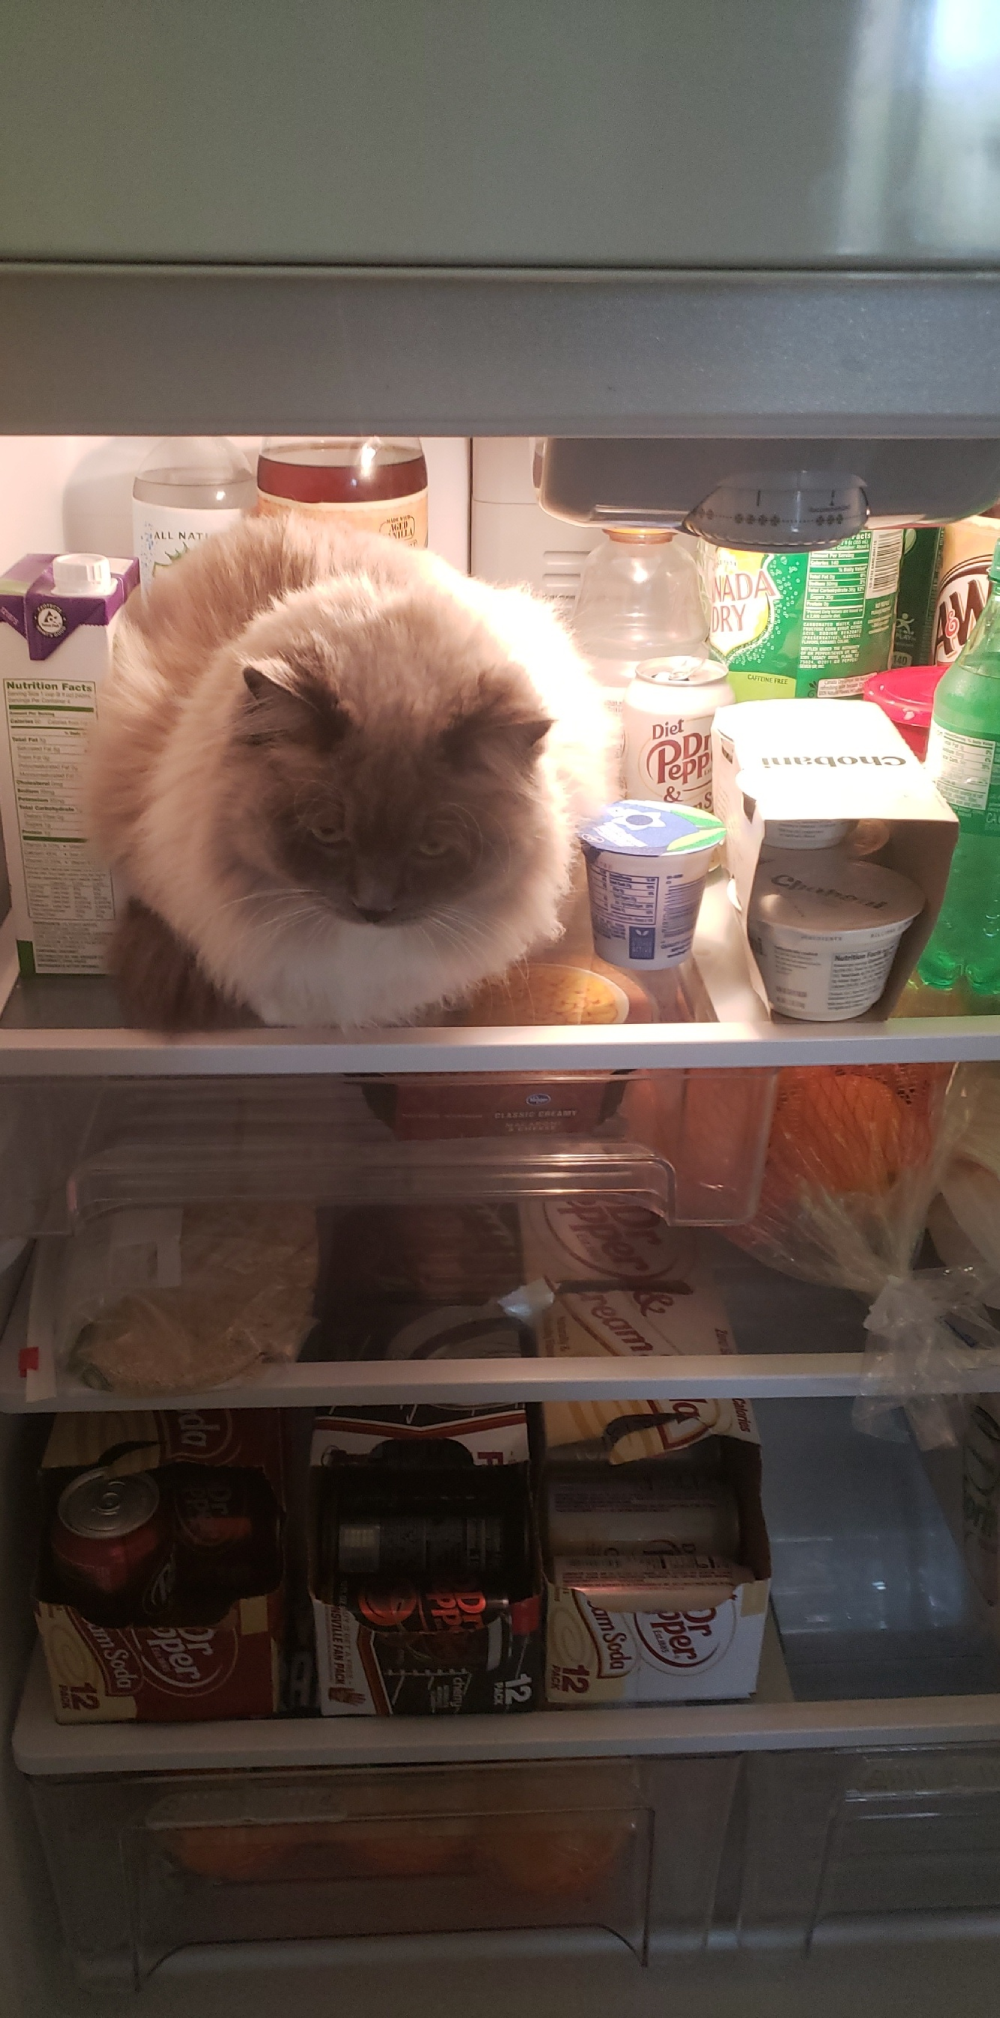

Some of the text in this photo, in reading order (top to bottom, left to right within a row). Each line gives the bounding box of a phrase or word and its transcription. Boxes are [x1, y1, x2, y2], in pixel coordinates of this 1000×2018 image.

[154, 531, 208, 540] ALL NAT
[388, 527, 413, 539] NILLA
[391, 520, 408, 532] AGED
[712, 570, 776, 603] NADA
[711, 604, 746, 633] DRY
[6, 681, 93, 692] Nutrition Facts
[747, 674, 788, 685] CAFFEINE FREE
[652, 718, 684, 740] Diet
[683, 732, 712, 760] Dr
[646, 739, 712, 785] Pepp
[761, 755, 906, 768] Chobani
[663, 786, 684, 803] &
[771, 874, 888, 910] Chobani
[834, 953, 866, 961] Nutrition
[494, 1109, 578, 1119] CLASSIC CREAMY
[557, 1201, 649, 1271] pper
[577, 1292, 653, 1351] ream
[178, 1410, 220, 1447] da
[732, 1398, 751, 1433] Calories
[650, 1612, 697, 1660] pper
[683, 1608, 717, 1637] Dr
[147, 1627, 201, 1681] pper
[331, 1606, 345, 1684] NSVILLE FAN PACK
[603, 1633, 631, 1670] Soda
[104, 1649, 138, 1690] Soda
[551, 1664, 562, 1690] PACK
[562, 1664, 590, 1694] 12
[58, 1684, 71, 1709] PACK
[69, 1682, 99, 1711] 12
[450, 1677, 464, 1708] cherry
[494, 1682, 504, 1705] PACK
[505, 1673, 532, 1705] 12
